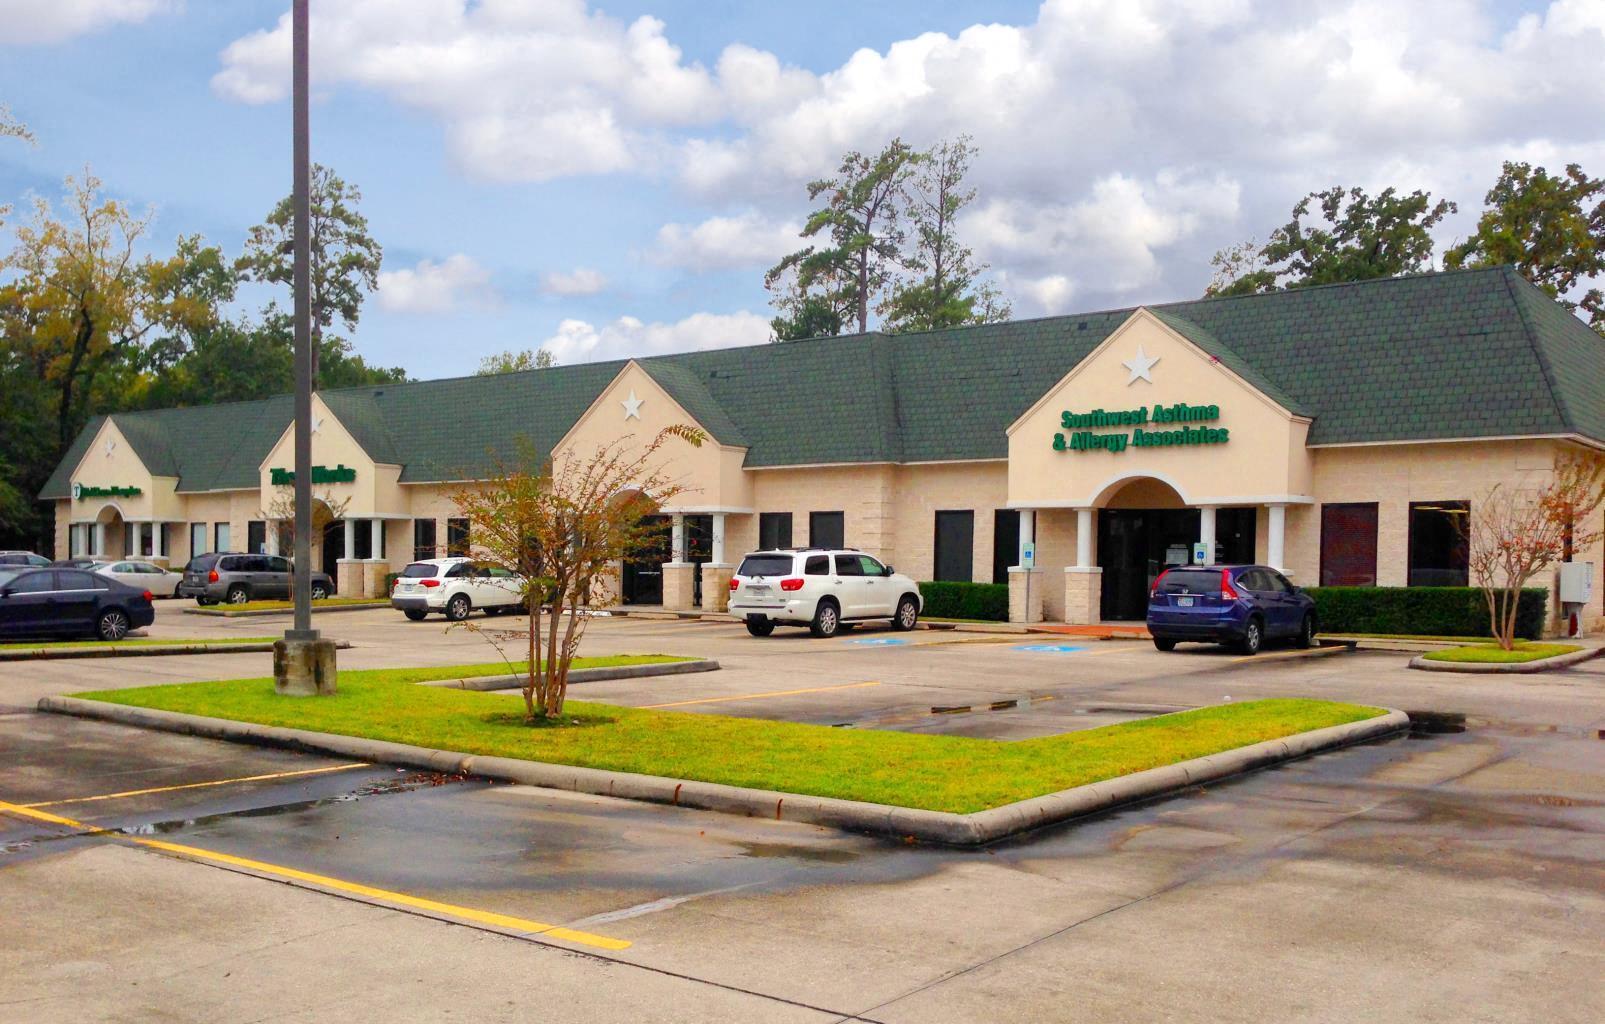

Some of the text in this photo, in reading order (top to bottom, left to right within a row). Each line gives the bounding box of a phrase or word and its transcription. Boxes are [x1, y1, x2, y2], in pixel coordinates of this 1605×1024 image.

[1061, 403, 1219, 428] Southwest Asthma
[1053, 426, 1229, 452] & Allergy Associates
